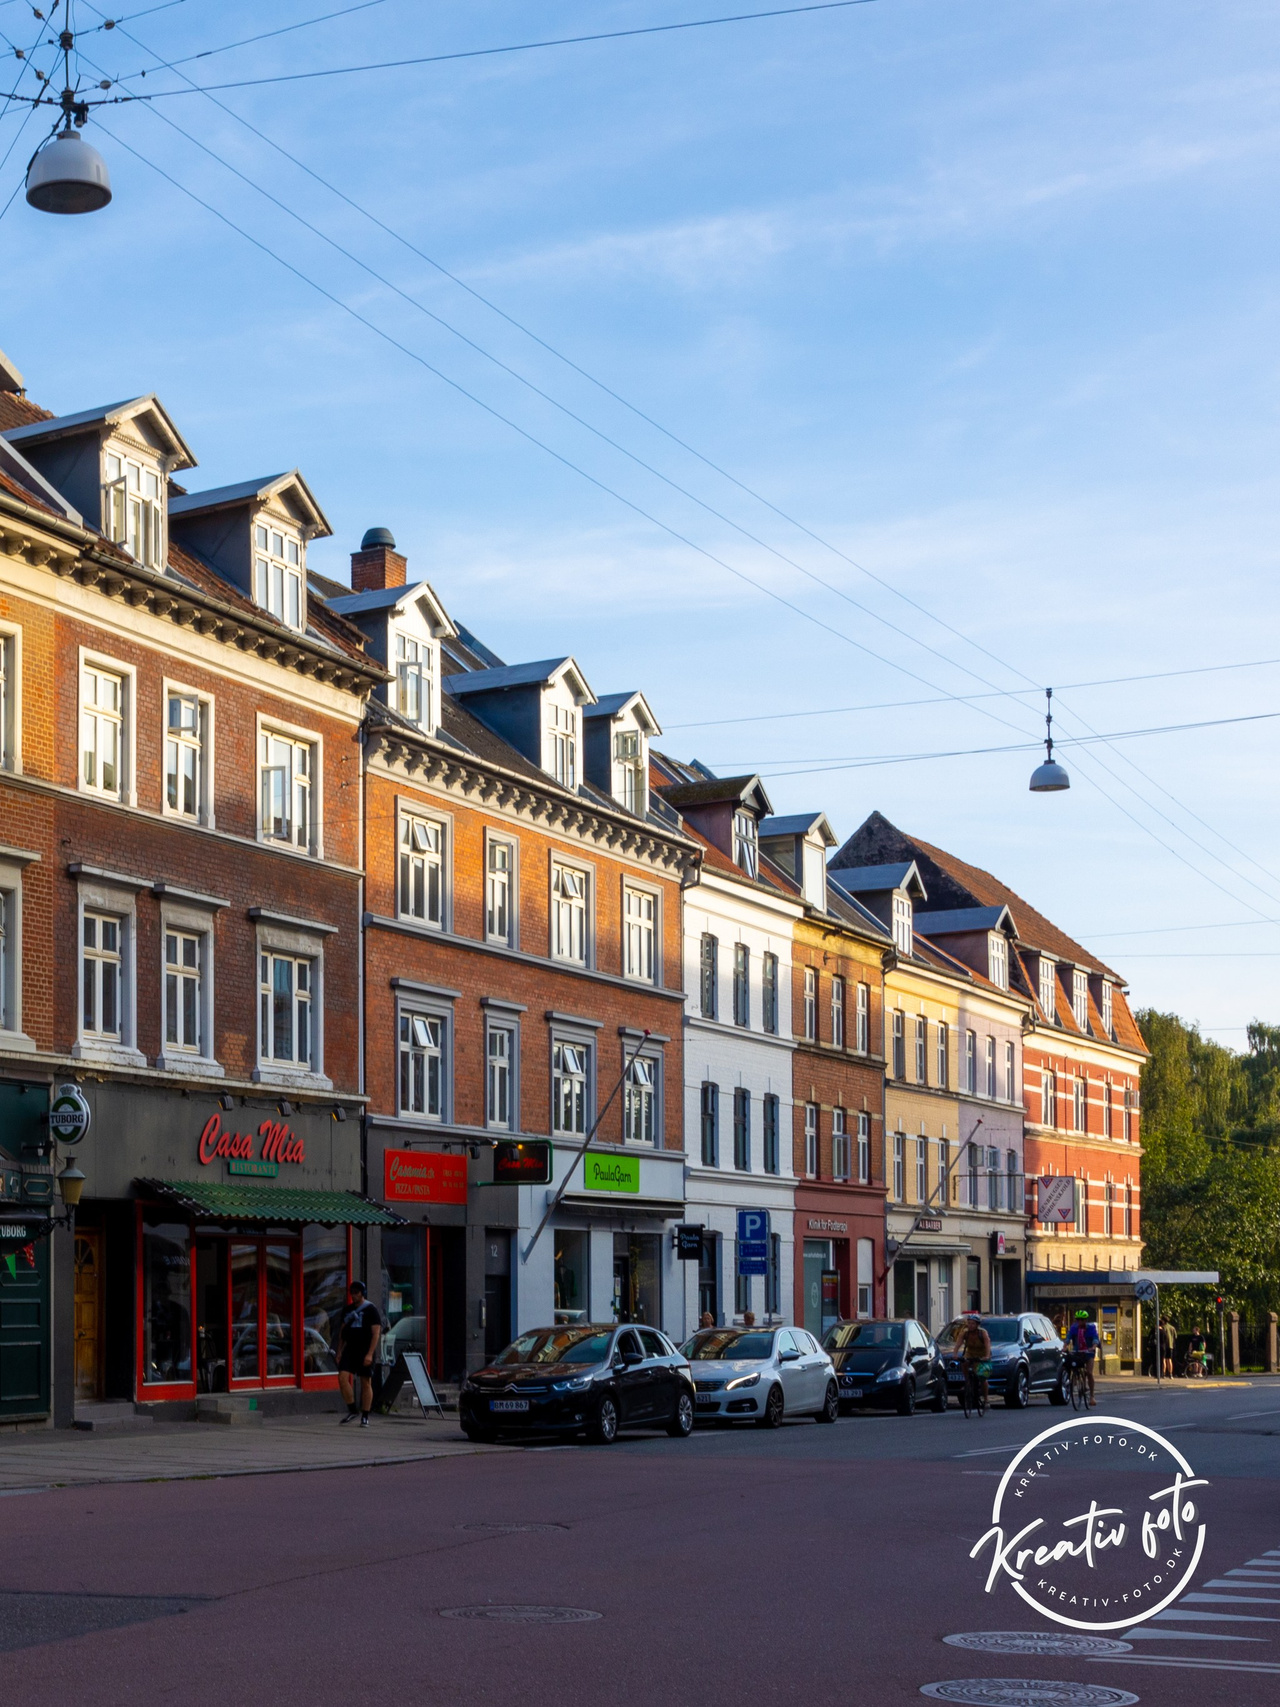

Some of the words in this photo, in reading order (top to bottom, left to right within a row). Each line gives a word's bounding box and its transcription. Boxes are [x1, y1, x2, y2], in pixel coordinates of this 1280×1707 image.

[50, 1114, 84, 1124] TUBORG
[199, 1113, 254, 1165] Casa
[259, 1119, 305, 1164] Mia
[745, 1214, 762, 1238] P
[490, 1244, 498, 1258] 12
[1137, 1285, 1153, 1296] 40
